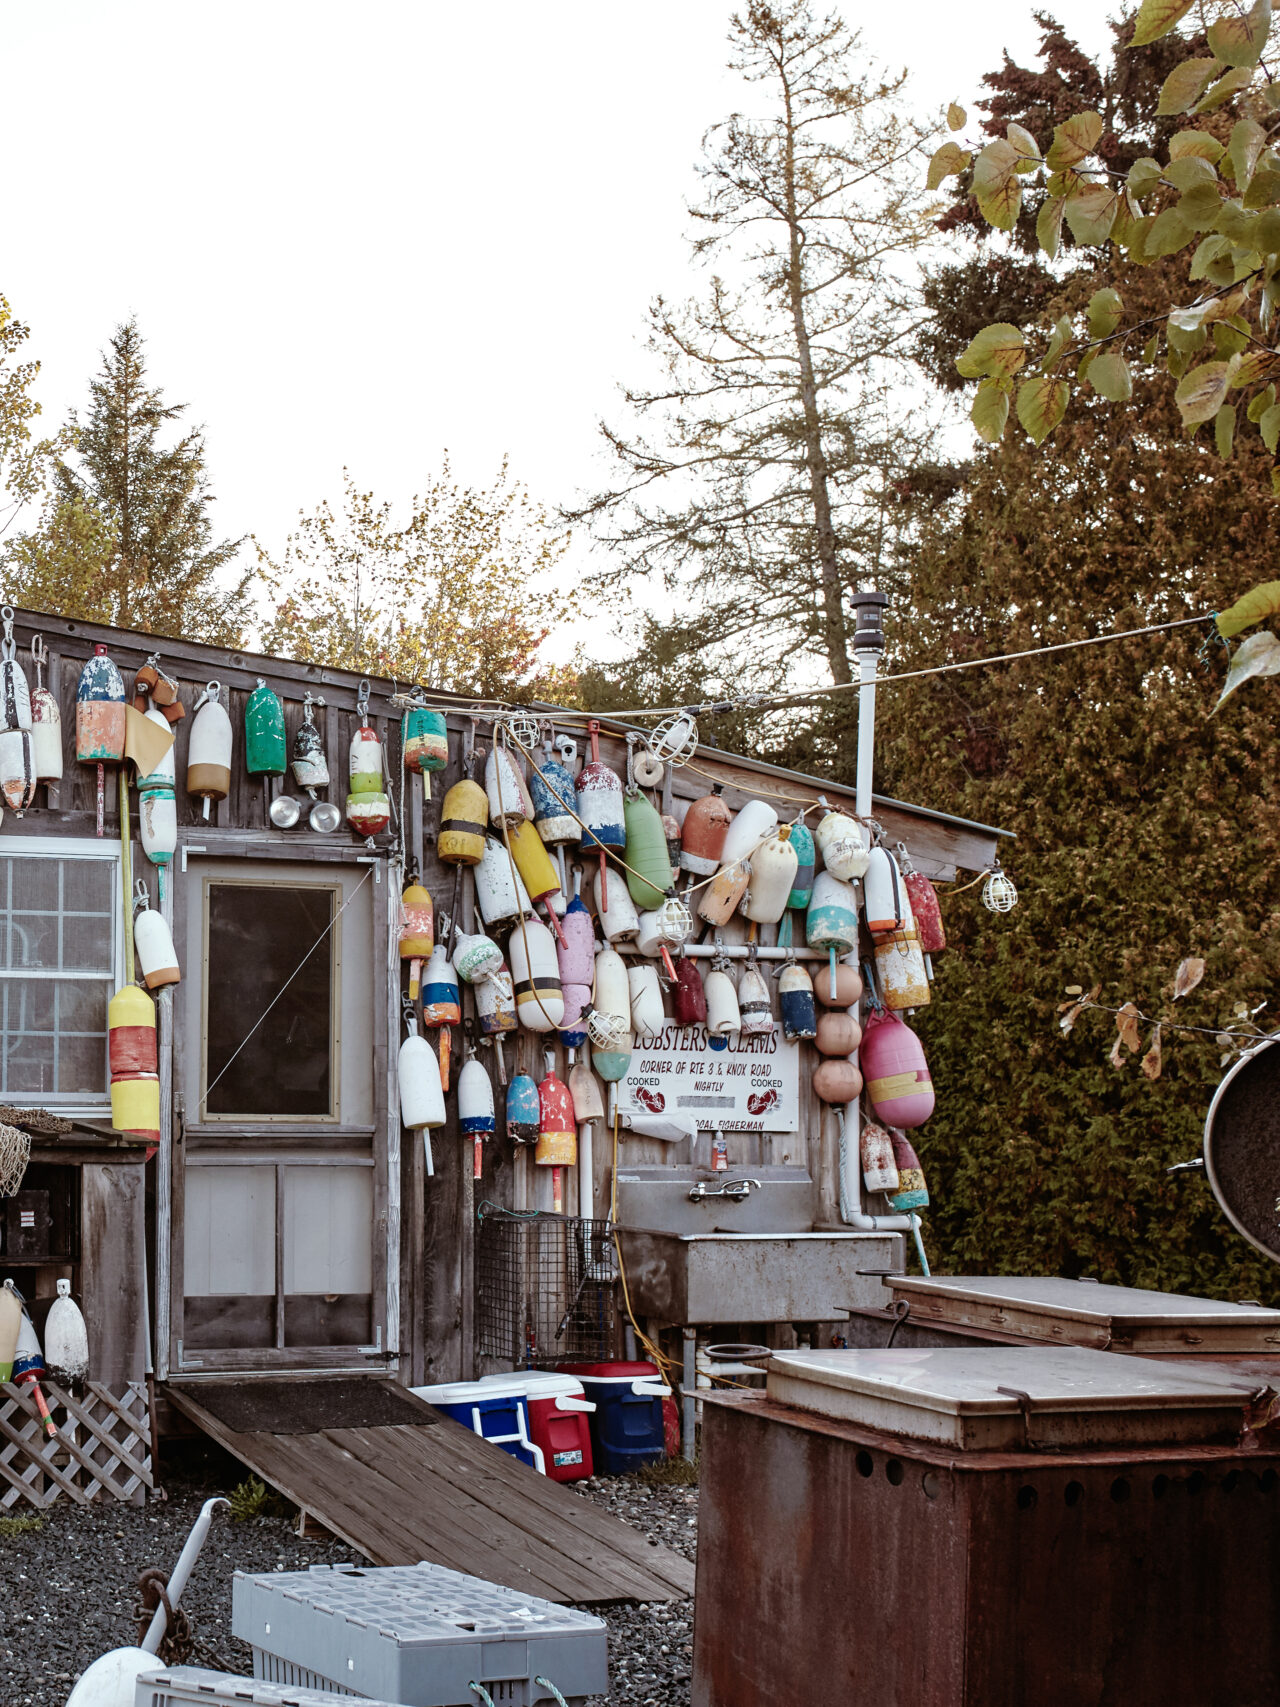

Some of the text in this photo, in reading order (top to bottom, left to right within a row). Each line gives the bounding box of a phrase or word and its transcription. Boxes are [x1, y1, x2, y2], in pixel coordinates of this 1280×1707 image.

[727, 1029, 779, 1054] CLAMS
[640, 1060, 772, 1077] CORNER OF RTE 3 & KNOX ROAD
[627, 1077, 660, 1086] COOKED
[694, 1081, 724, 1092] NIGHTLY
[751, 1078, 783, 1088] COOKED
[718, 1120, 765, 1131] FISHERMAN
